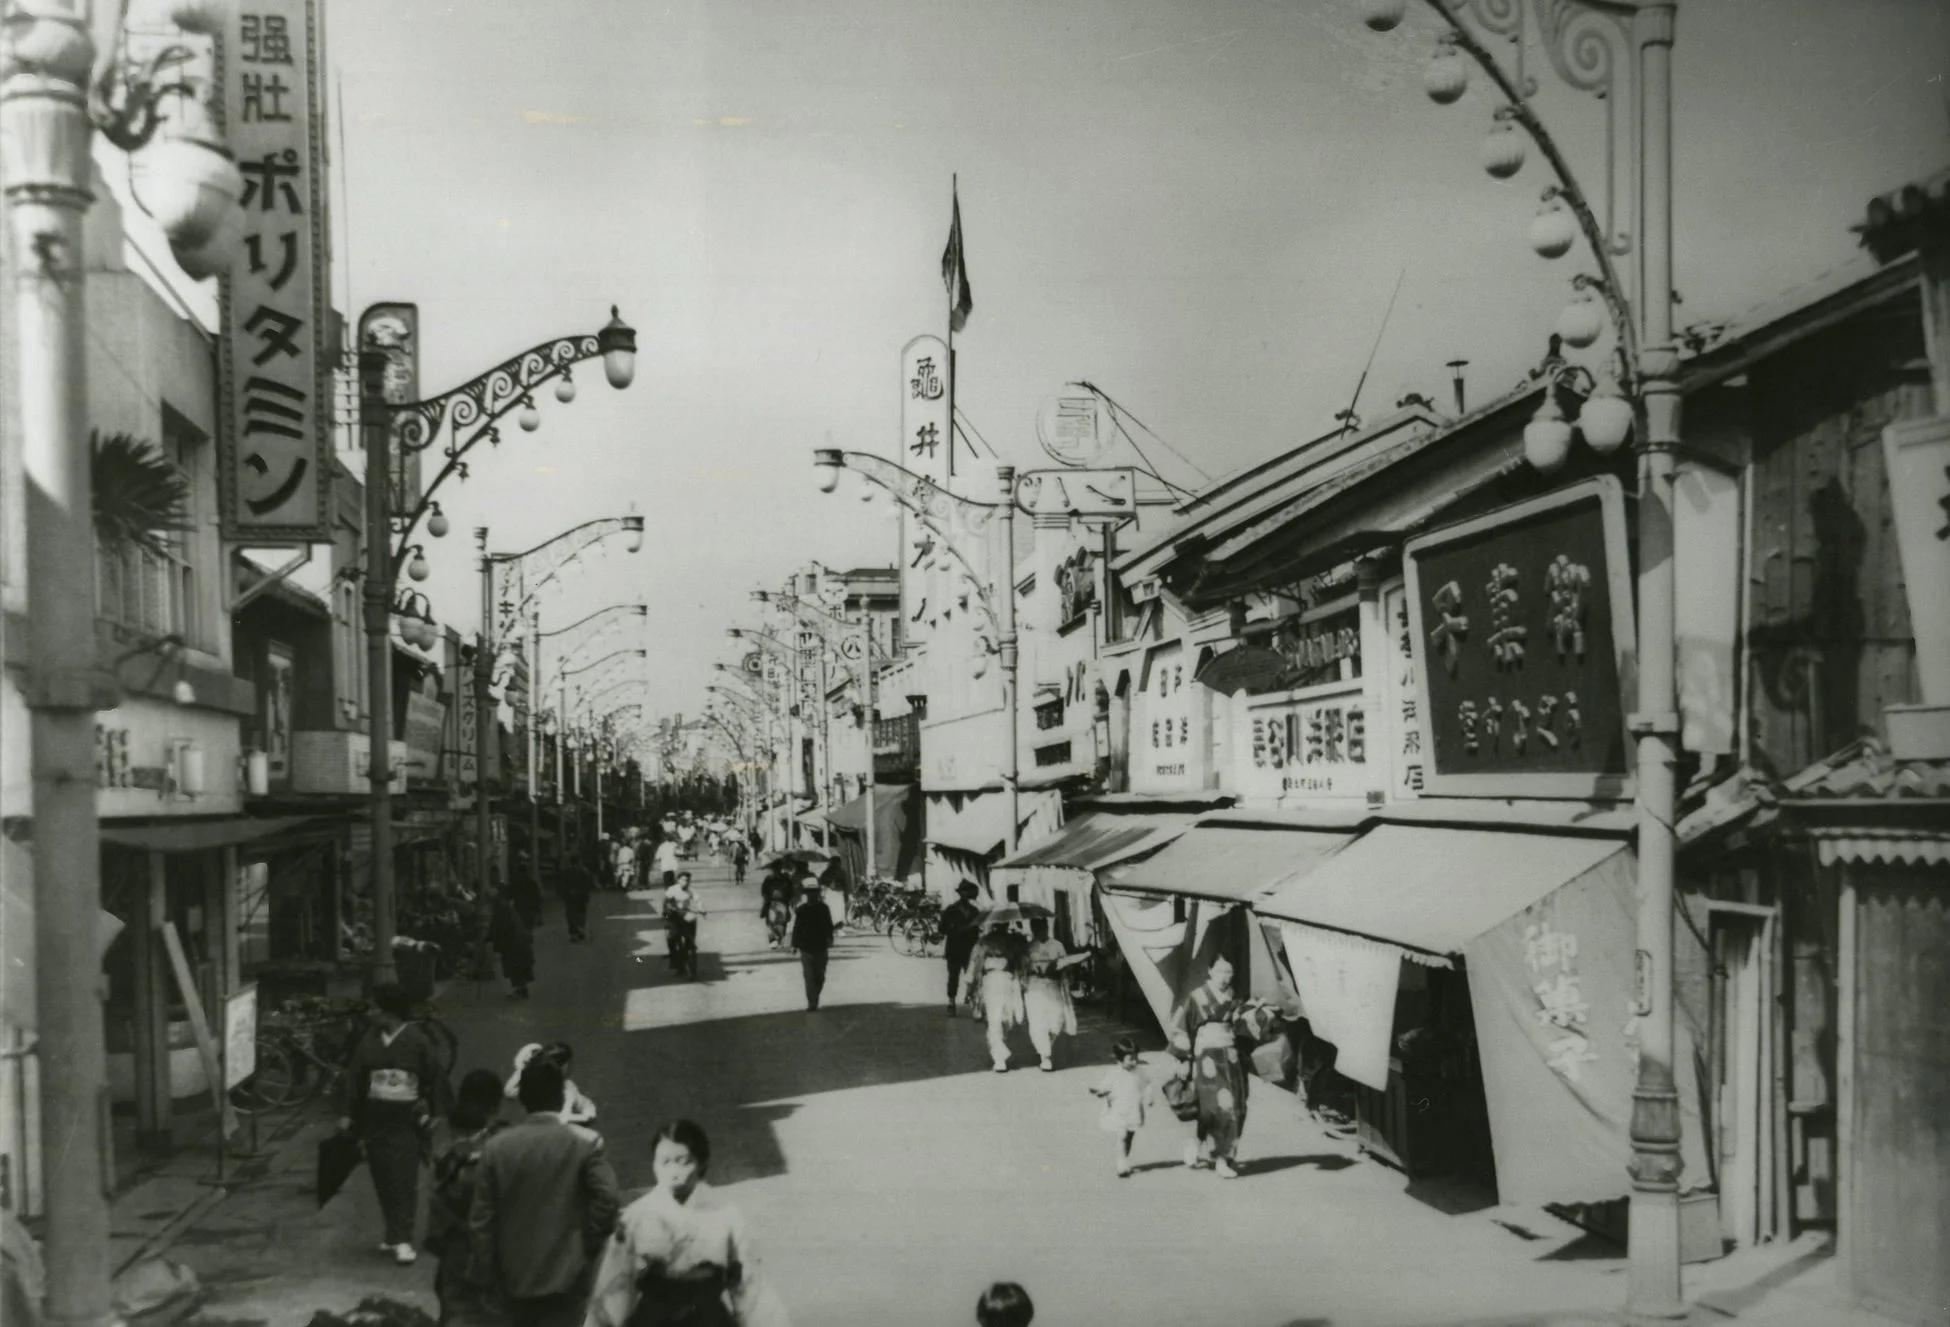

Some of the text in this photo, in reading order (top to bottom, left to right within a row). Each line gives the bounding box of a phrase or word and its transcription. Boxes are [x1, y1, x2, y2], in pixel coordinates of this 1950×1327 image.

[239, 149, 308, 516] ポリタミン
